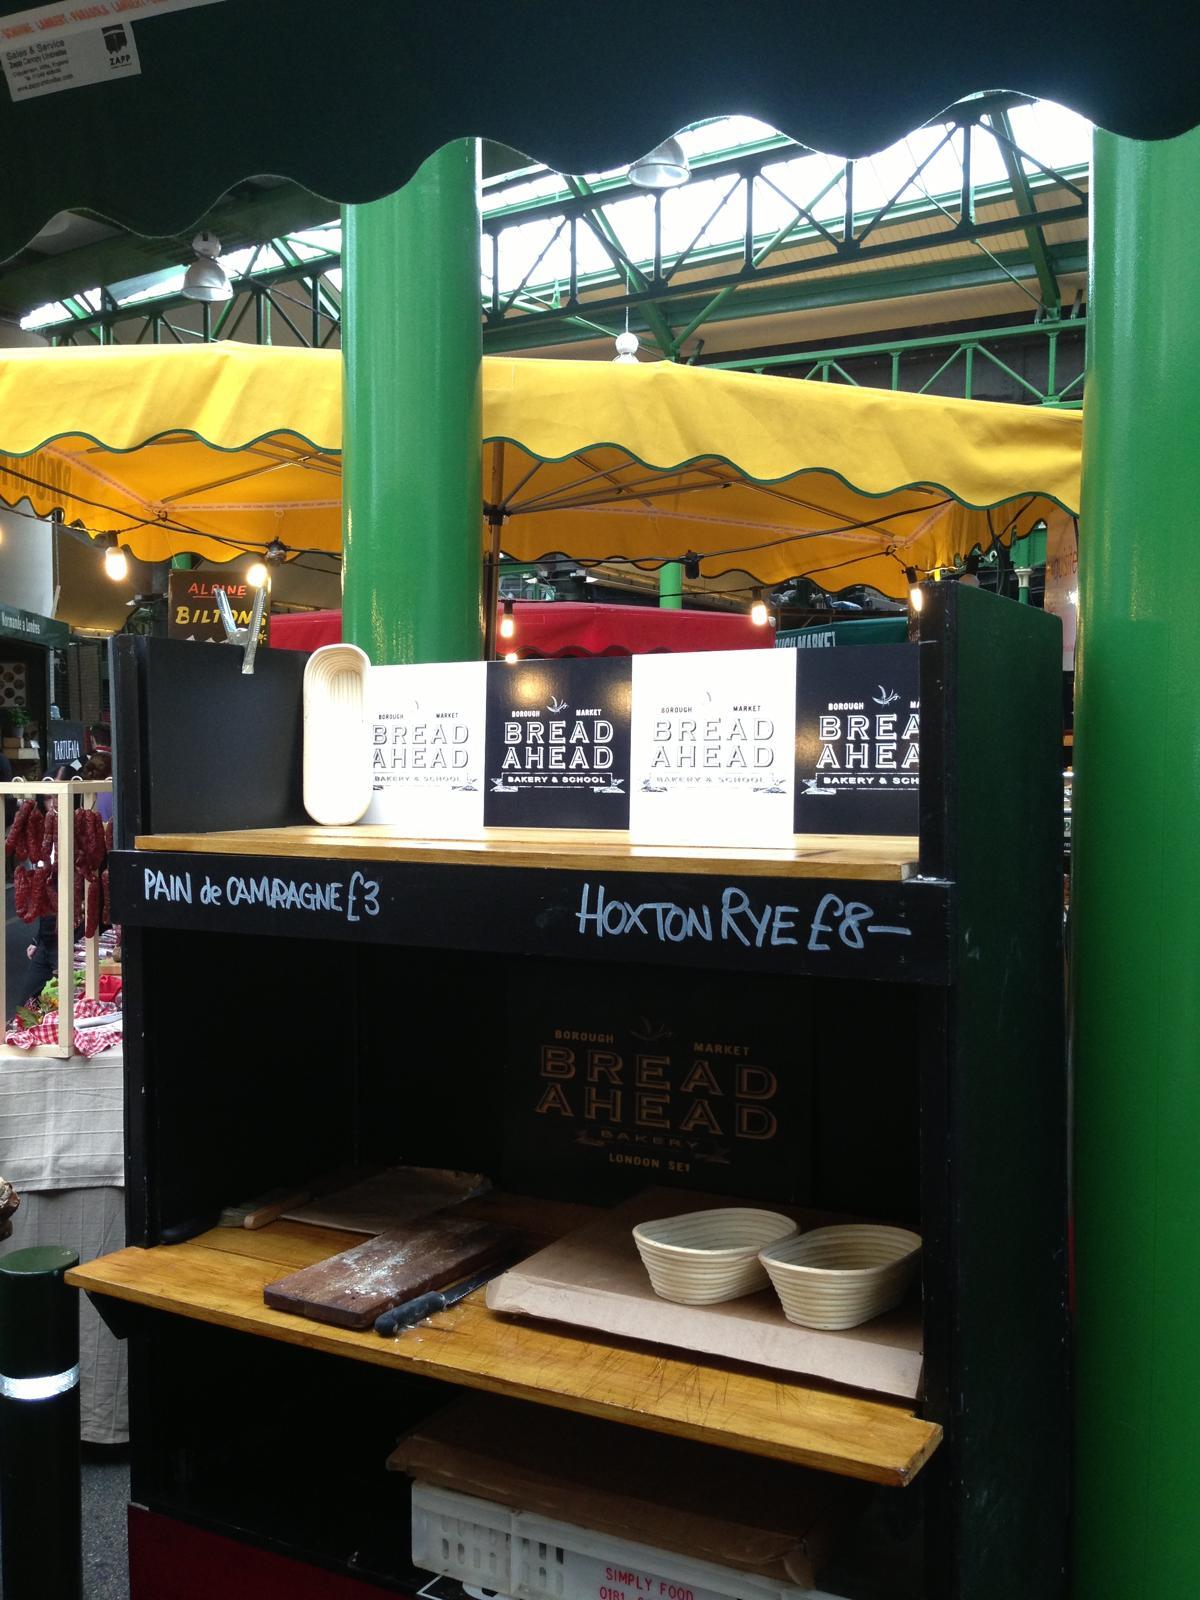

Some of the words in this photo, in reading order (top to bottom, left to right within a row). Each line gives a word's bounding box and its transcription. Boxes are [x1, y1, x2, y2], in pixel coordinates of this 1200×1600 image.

[110, 54, 131, 66] ZAPP
[188, 582, 247, 595] ALPINE
[797, 631, 836, 648] MARKET
[511, 710, 540, 718] BOROUGH
[661, 706, 692, 714] BOROUGH
[828, 702, 864, 711] BOROUGH
[373, 724, 469, 745] BREAD
[504, 720, 614, 744] BREAD
[653, 718, 775, 742] BREAD
[373, 747, 469, 769] AHEAD
[501, 746, 614, 770] AHEAD
[651, 745, 775, 768] AHEAD
[144, 868, 192, 904] PAIN
[200, 876, 222, 906] de
[226, 875, 344, 912] CAMPAGNE
[347, 871, 381, 921] £3
[575, 882, 713, 942] HOXTON
[721, 886, 800, 948] RYE
[554, 1028, 615, 1043] BOROUGH
[693, 1041, 752, 1056] MARKET
[539, 1044, 777, 1101] BREAD
[534, 1082, 778, 1140] AHEAD
[600, 1128, 699, 1149] BAKERY
[609, 1152, 660, 1169] LONDON
[605, 1567, 652, 1591] SIMPLY
[660, 1582, 694, 1600] FOOD
